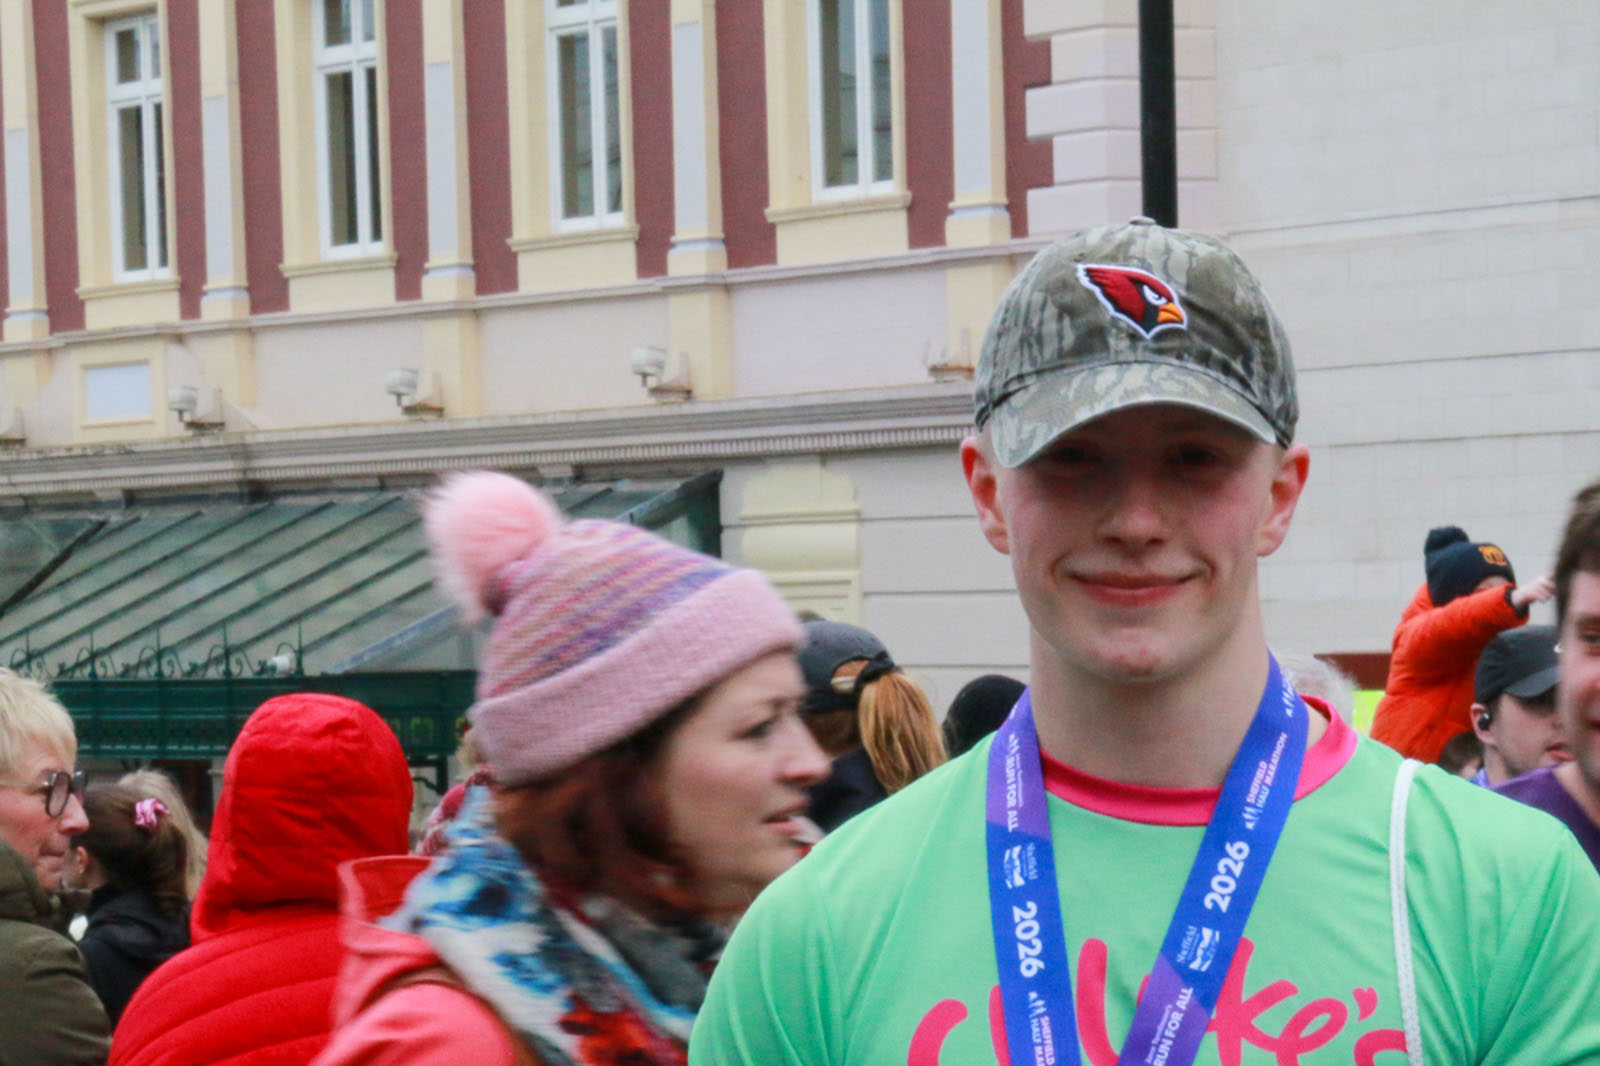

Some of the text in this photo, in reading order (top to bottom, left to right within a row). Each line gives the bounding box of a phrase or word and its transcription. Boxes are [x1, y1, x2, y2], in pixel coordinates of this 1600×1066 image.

[1203, 840, 1251, 914] 2026
[1012, 900, 1046, 979] 2026
[1164, 1010, 1185, 1040] FOR
[1175, 986, 1194, 1011] ALL
